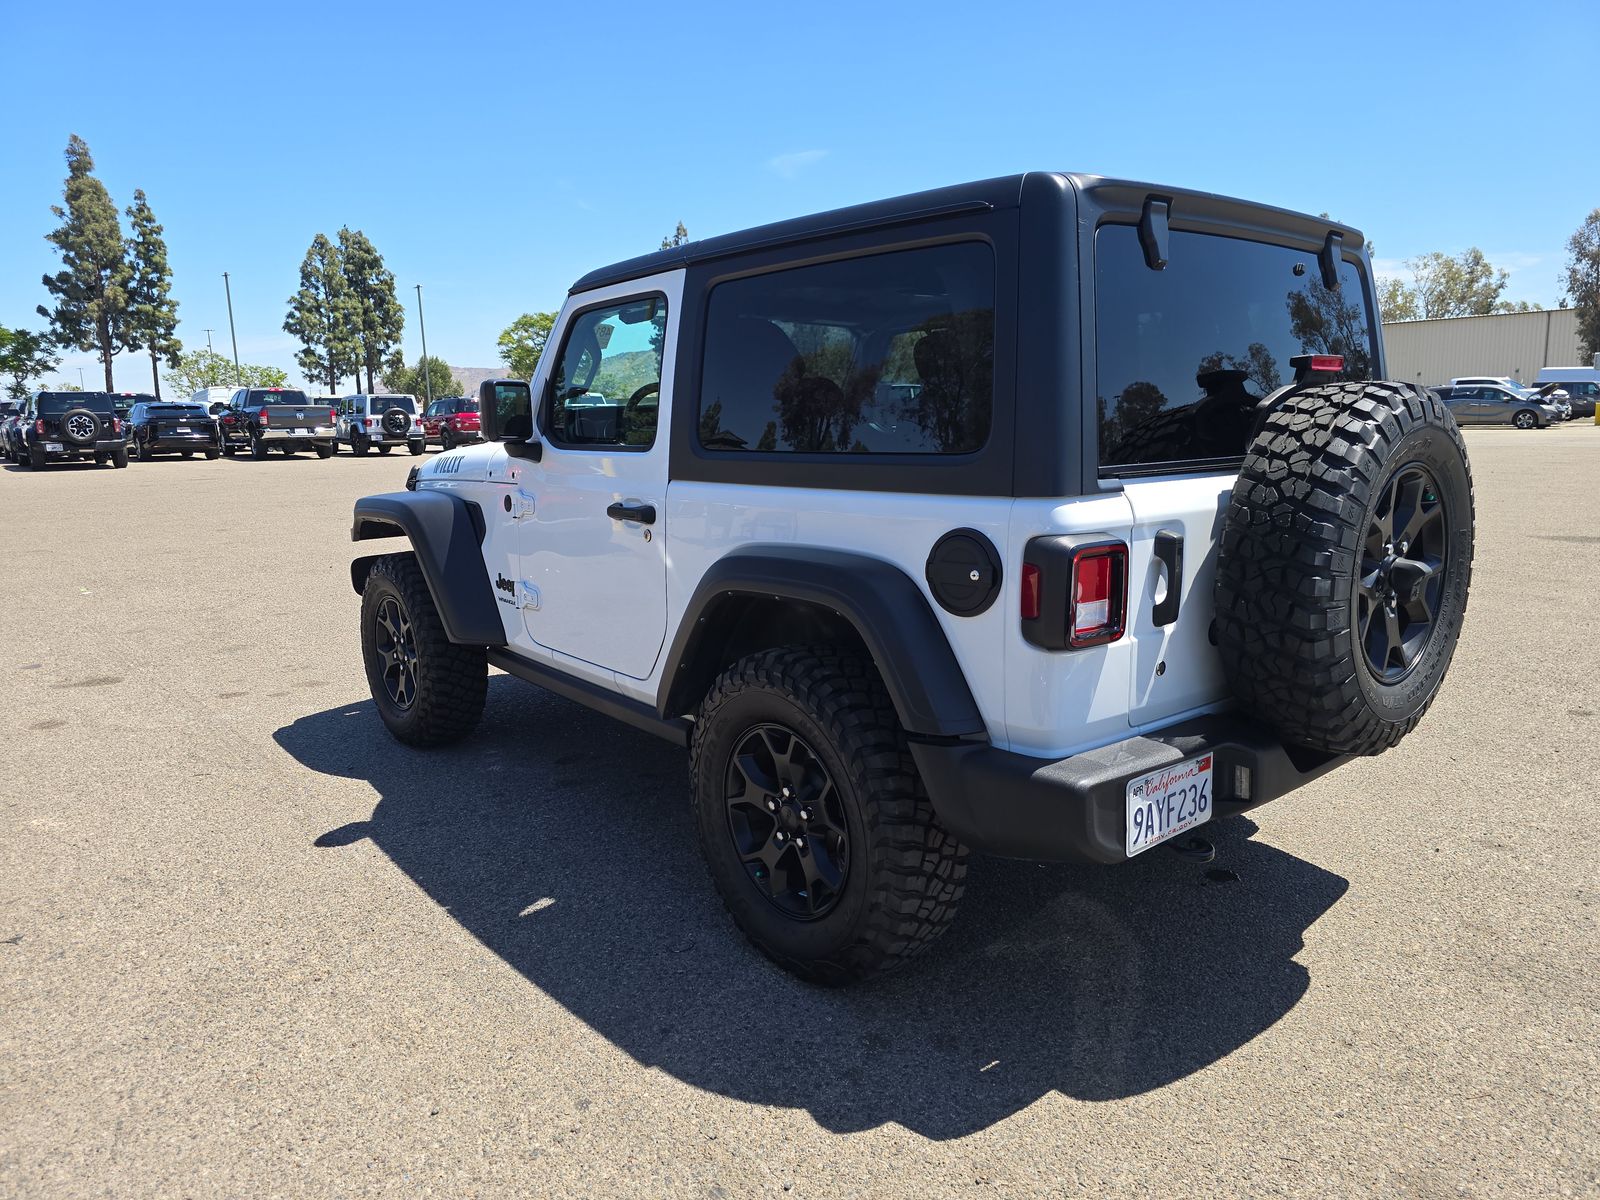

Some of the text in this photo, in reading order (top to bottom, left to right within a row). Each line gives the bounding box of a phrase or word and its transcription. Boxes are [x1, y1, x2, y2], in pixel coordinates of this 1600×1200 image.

[433, 455, 465, 474] WILLYS
[1146, 770, 1198, 796] California
[1133, 778, 1208, 845] 9AYF236
